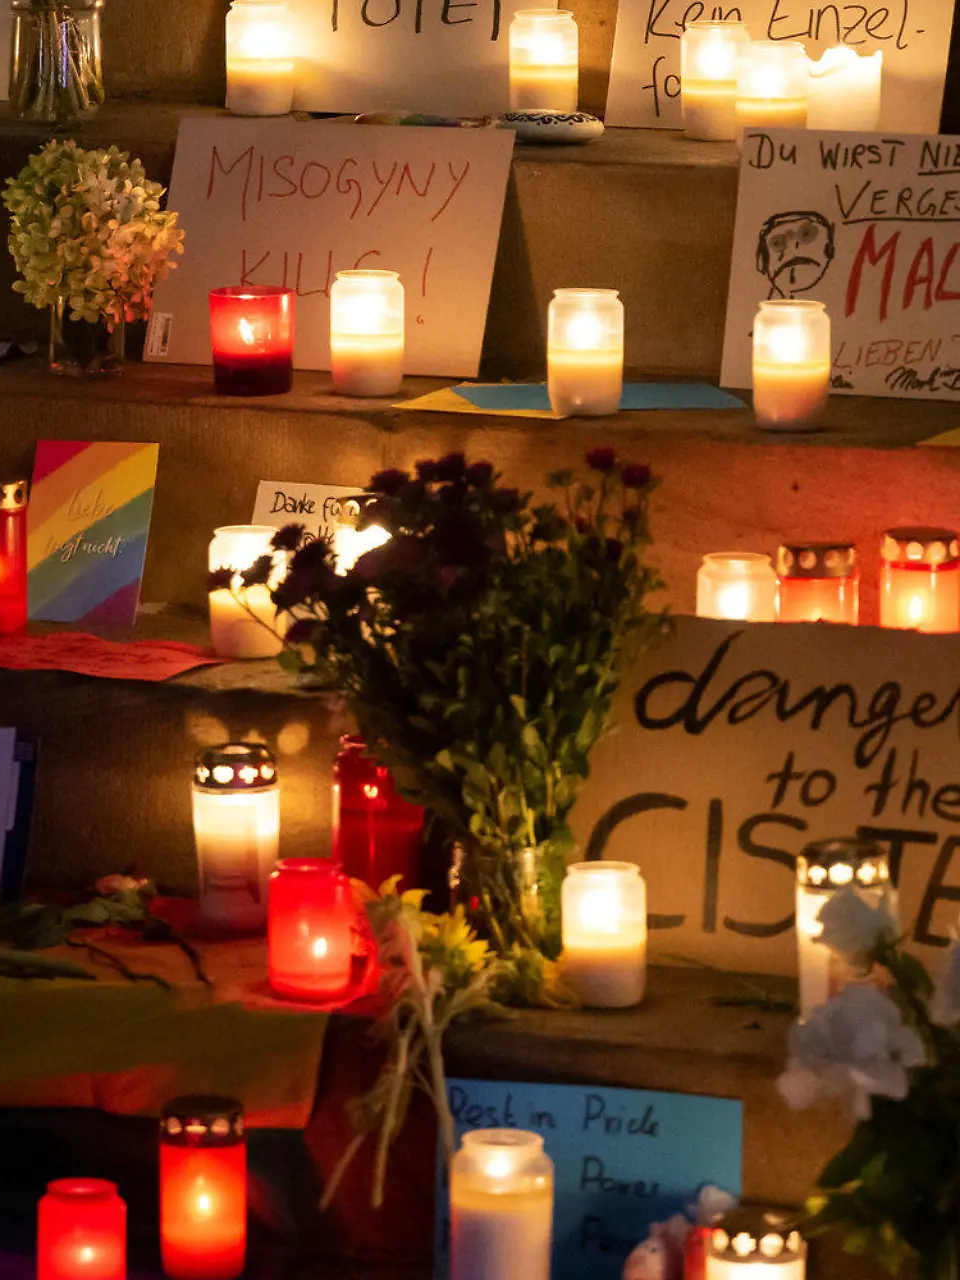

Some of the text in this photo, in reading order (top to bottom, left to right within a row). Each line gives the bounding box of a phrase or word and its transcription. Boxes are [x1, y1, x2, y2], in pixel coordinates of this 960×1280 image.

[820, 140, 906, 170] WIRST
[207, 146, 470, 222] MISOGYNY
[835, 180, 960, 220] VERGE
[270, 491, 316, 514] Danke
[766, 751, 837, 809] to
